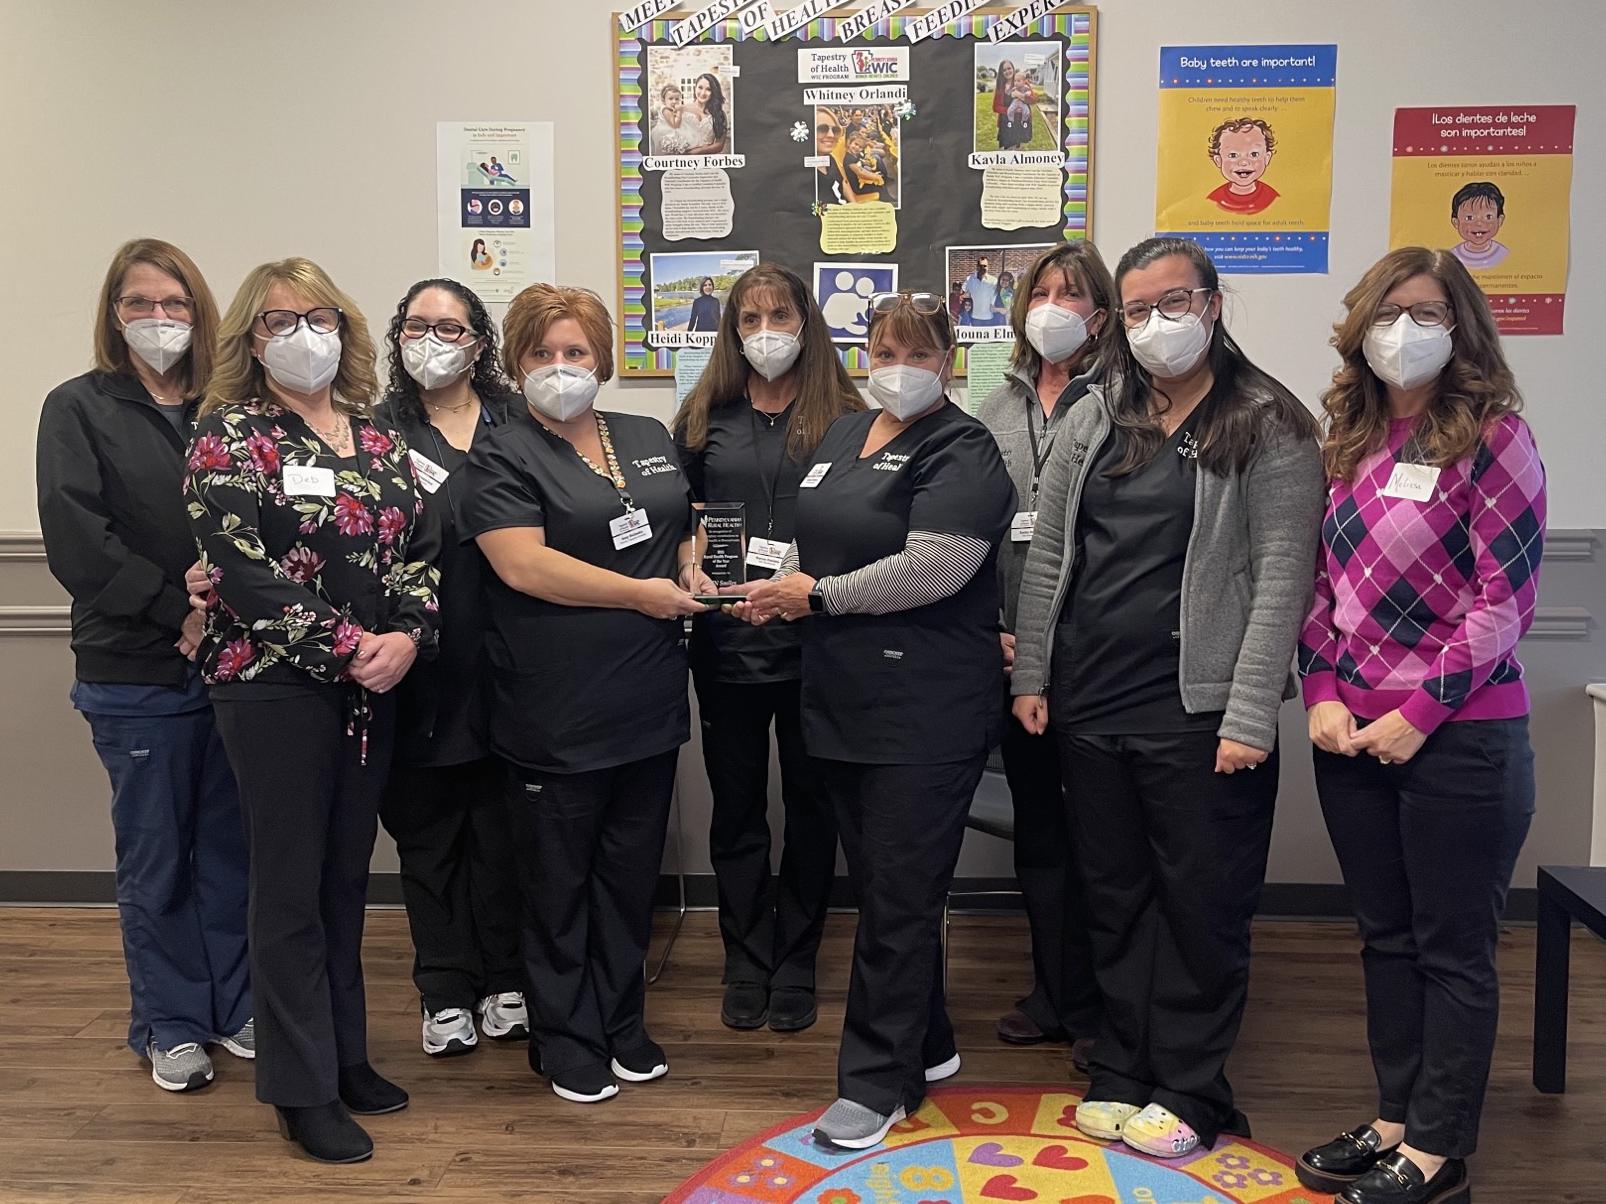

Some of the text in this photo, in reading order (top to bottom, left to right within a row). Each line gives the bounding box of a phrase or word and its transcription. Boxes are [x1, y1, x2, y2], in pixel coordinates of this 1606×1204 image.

[624, 0, 1063, 44] MEE TAPES OF HEAL BREAS FEEDI EXPER
[811, 54, 847, 62] Tapestry
[1180, 56, 1316, 70] Baby teeth are important!
[810, 65, 849, 73] of Health
[871, 62, 898, 74] WIC
[805, 88, 906, 102] Whitney Orlandi
[1228, 96, 1250, 104] healthy
[1275, 96, 1289, 104] help
[1456, 113, 1493, 124] dientes
[1495, 112, 1508, 123] de
[1510, 112, 1537, 123] leche
[1441, 125, 1526, 139] son importantes!
[644, 156, 744, 170] Courtney Forbes
[1010, 153, 1064, 165] Almoney
[1479, 161, 1501, 169] ayudan
[650, 333, 681, 344] Heidi
[956, 328, 990, 340] ouna
[632, 456, 666, 468] Tapestry
[641, 463, 677, 476] of Health
[288, 474, 319, 485] Deb
[901, 1164, 955, 1192] 8
